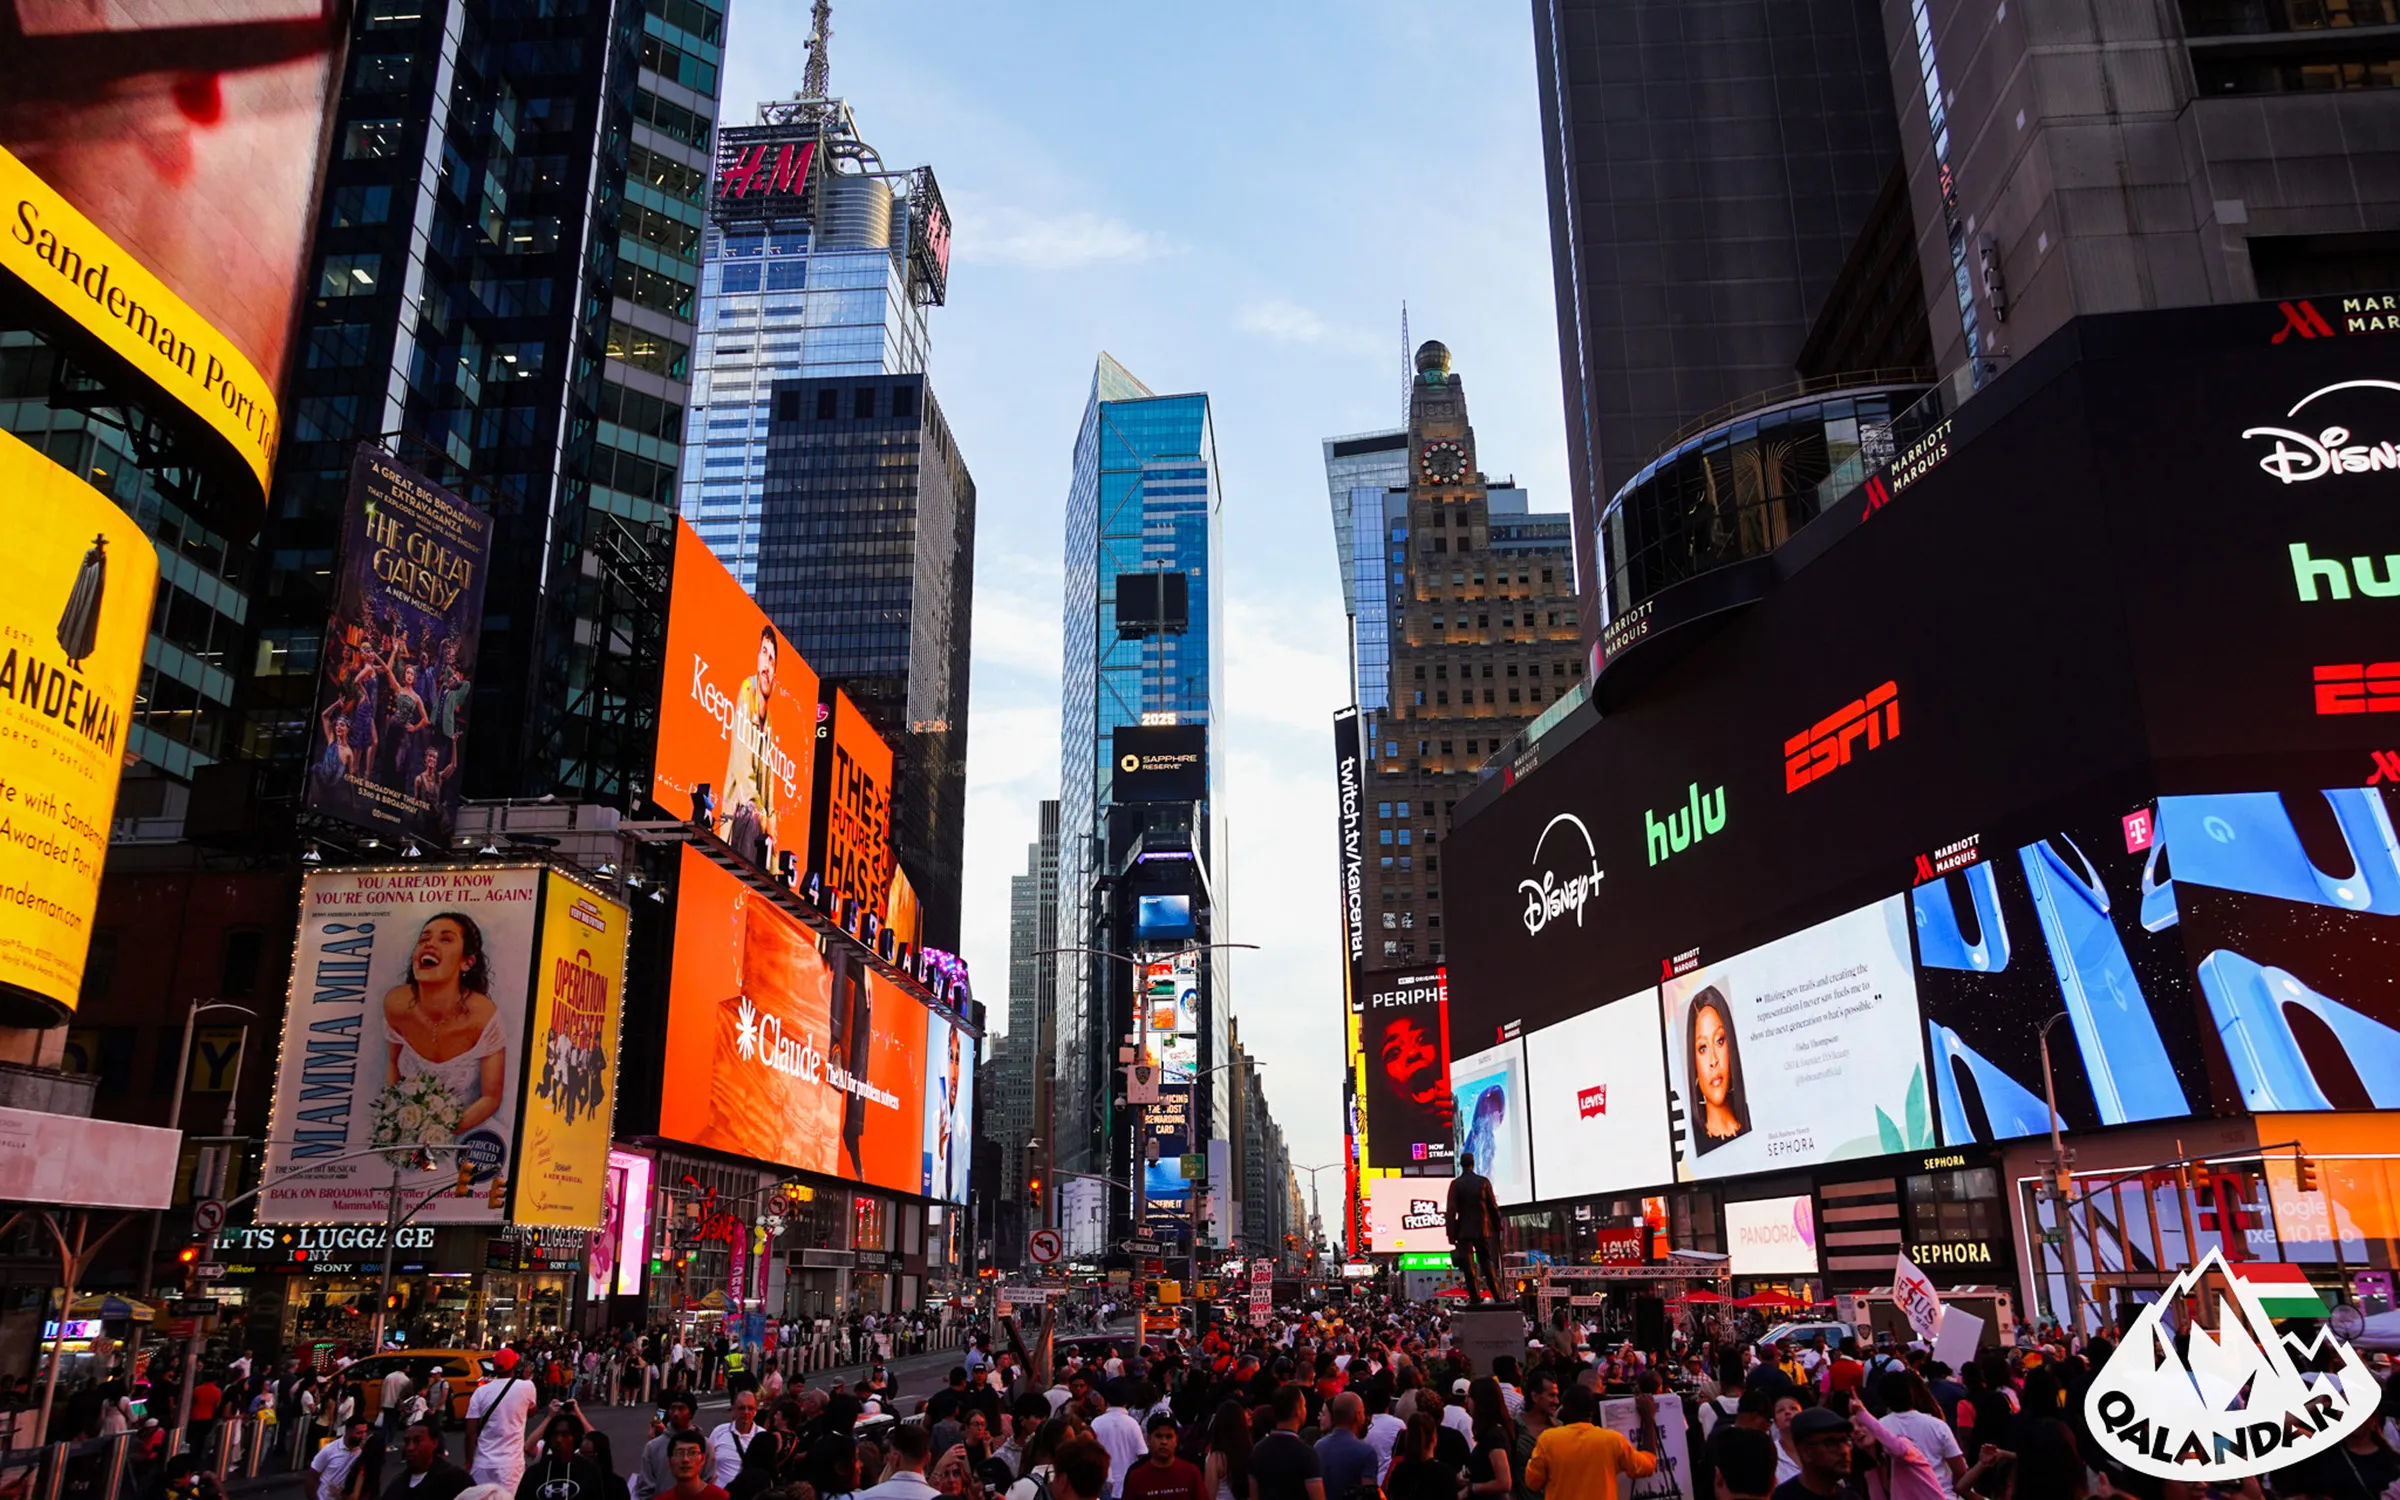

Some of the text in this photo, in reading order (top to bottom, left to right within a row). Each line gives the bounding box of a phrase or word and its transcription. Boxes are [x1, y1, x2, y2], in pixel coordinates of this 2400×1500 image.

[720, 141, 816, 199] H&M
[925, 201, 951, 281] H&M
[11, 200, 255, 431] Sandeman Port
[1891, 419, 1953, 475] MARRIOTT
[1893, 443, 1949, 493] MARQUIS
[381, 466, 414, 494] GREAT,
[416, 486, 433, 504] BIG
[434, 497, 484, 532] BROADWAY
[391, 485, 462, 534] EXTRAVAGANZA
[366, 508, 475, 590] THE GREAT
[373, 549, 460, 611] GATSBY
[393, 588, 410, 604] NEW
[411, 597, 443, 619] MUSICAL
[1604, 601, 1654, 643] MARRIOTT
[1605, 621, 1649, 659] MARQUIS
[690, 653, 797, 799] Keep thinking
[1141, 712, 1176, 726] 2025
[1784, 680, 1900, 794] ESPN
[1142, 754, 1197, 764] SAPPHIRE
[1514, 743, 1541, 768] MARRIOTT
[1514, 756, 1539, 780] MARQUIS
[836, 742, 874, 829] THE
[25, 793, 57, 820] with
[832, 802, 871, 860] FUTURE
[1644, 781, 1728, 867] hulu
[0, 815, 71, 864] Awarded
[870, 788, 883, 914] MANY
[1934, 833, 1980, 859] MARRIOTT
[829, 830, 868, 910] HAS
[1935, 848, 1977, 872] MARQUIS
[357, 874, 496, 889] YOU ALREADY KNOW
[315, 888, 533, 905] YOU'RE GONNA LOVE IT... AGAIN!
[313, 921, 377, 1005] MIA!
[1673, 947, 1700, 964] MARRIOTT
[1674, 958, 1698, 974] MARQUIS
[1857, 963, 1868, 975] the
[554, 957, 608, 1013] OPERATION
[1415, 974, 1442, 982] ORIGINAL
[1372, 986, 1448, 1008] PERIPHE
[758, 1013, 821, 1086] Claude
[291, 1013, 363, 1160] MAMMA
[826, 1062, 839, 1085] The
[839, 1069, 847, 1089] AI
[847, 1071, 857, 1093] for
[1156, 1125, 1174, 1135] CARD
[1428, 1143, 1444, 1151] NOW
[1767, 1137, 1815, 1157] SEPHORA
[1924, 1155, 1965, 1170] SEPHORA
[270, 1188, 374, 1199] BACK ON BROADWAY
[1404, 1211, 1447, 1227] FRIENDS
[539, 1229, 584, 1249] LUGGAGE
[1739, 1222, 1799, 1245] PANDORA
[2316, 1224, 2354, 1244] Po
[1912, 1243, 1991, 1265] SEPHORA
[226, 1264, 257, 1274] Nikon
[313, 1263, 352, 1273] SONY
